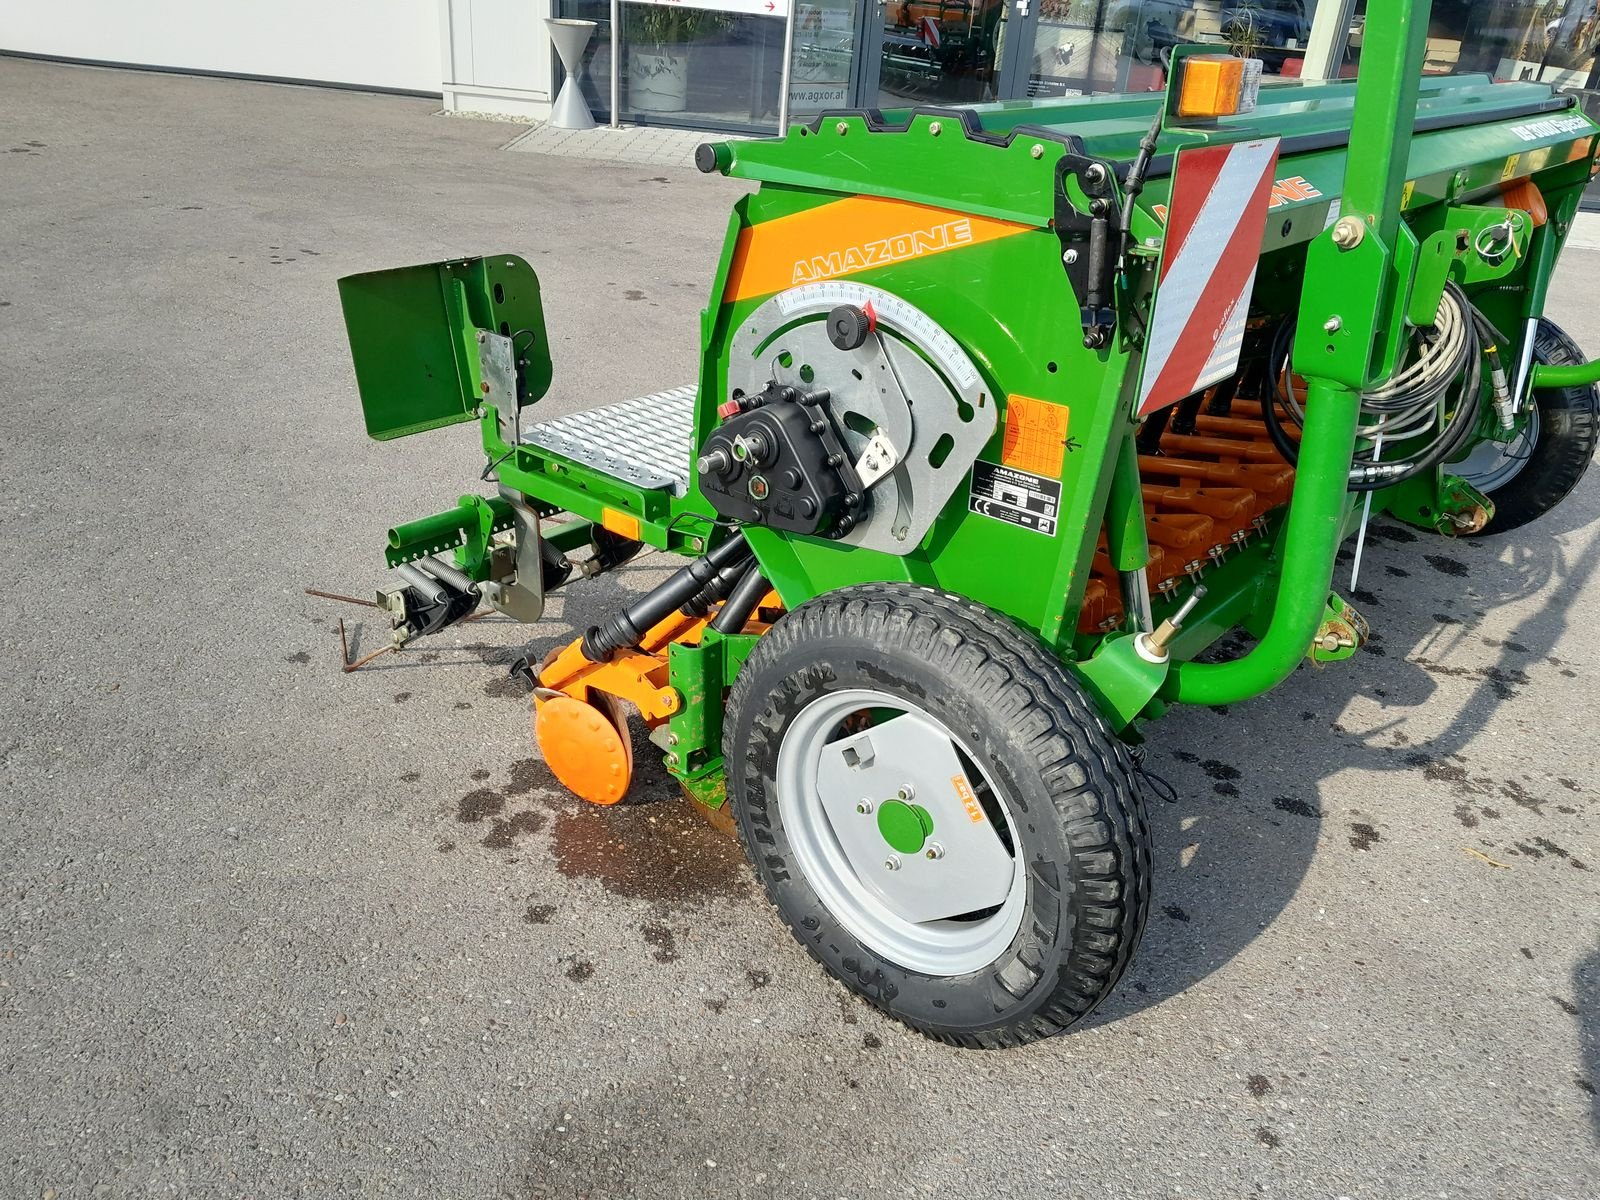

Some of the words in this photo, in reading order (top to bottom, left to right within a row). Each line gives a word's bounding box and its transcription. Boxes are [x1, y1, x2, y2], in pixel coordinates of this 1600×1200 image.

[788, 89, 843, 103] ww.agxor.at
[792, 218, 972, 284] AMAZONE
[993, 467, 1040, 485] AMAZONE
[956, 780, 970, 801] bar
